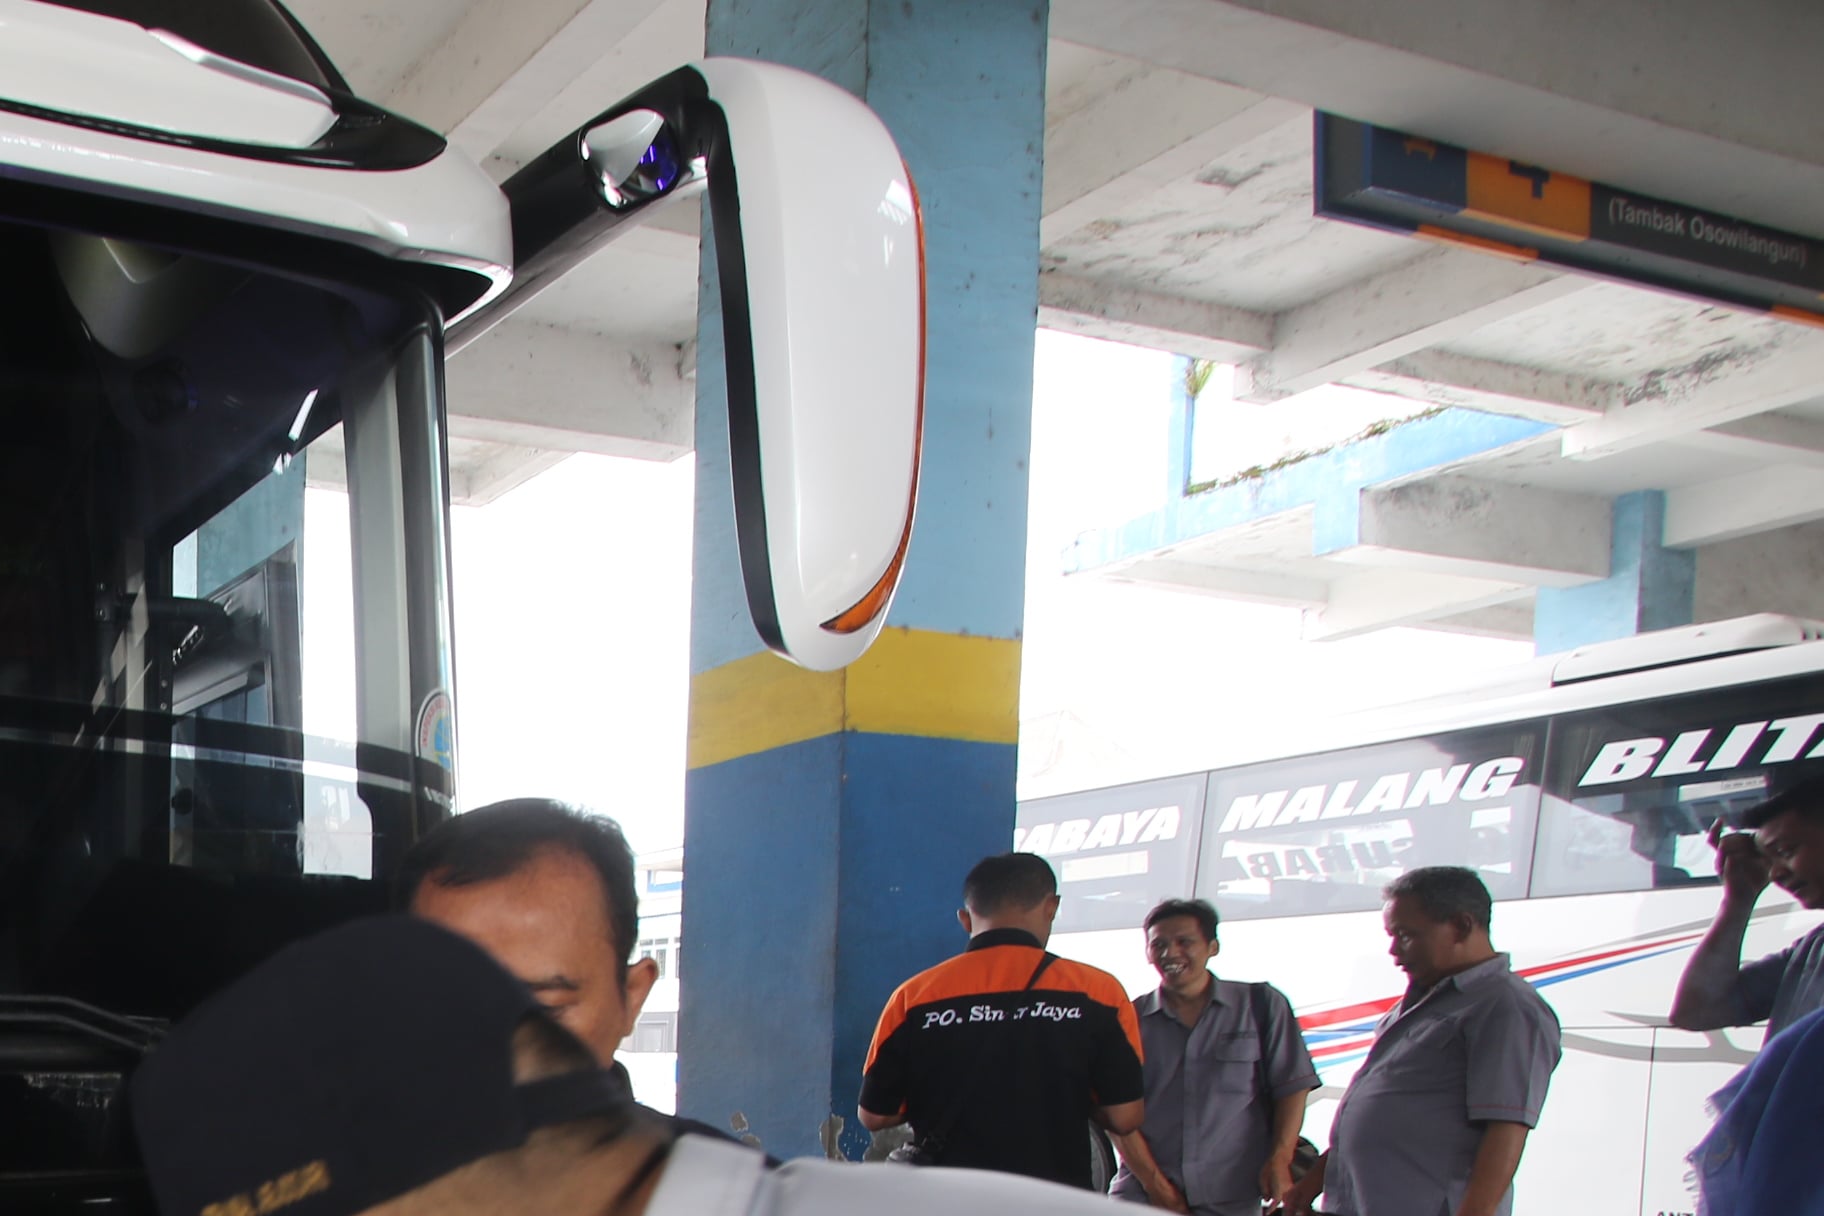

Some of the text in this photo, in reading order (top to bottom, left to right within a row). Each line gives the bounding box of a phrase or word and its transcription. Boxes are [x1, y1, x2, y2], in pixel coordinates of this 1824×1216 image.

[1608, 197, 1685, 236] (Tambak
[1218, 757, 1524, 834] MALANG
[923, 1002, 1081, 1029] PO. Sinr Jaya
